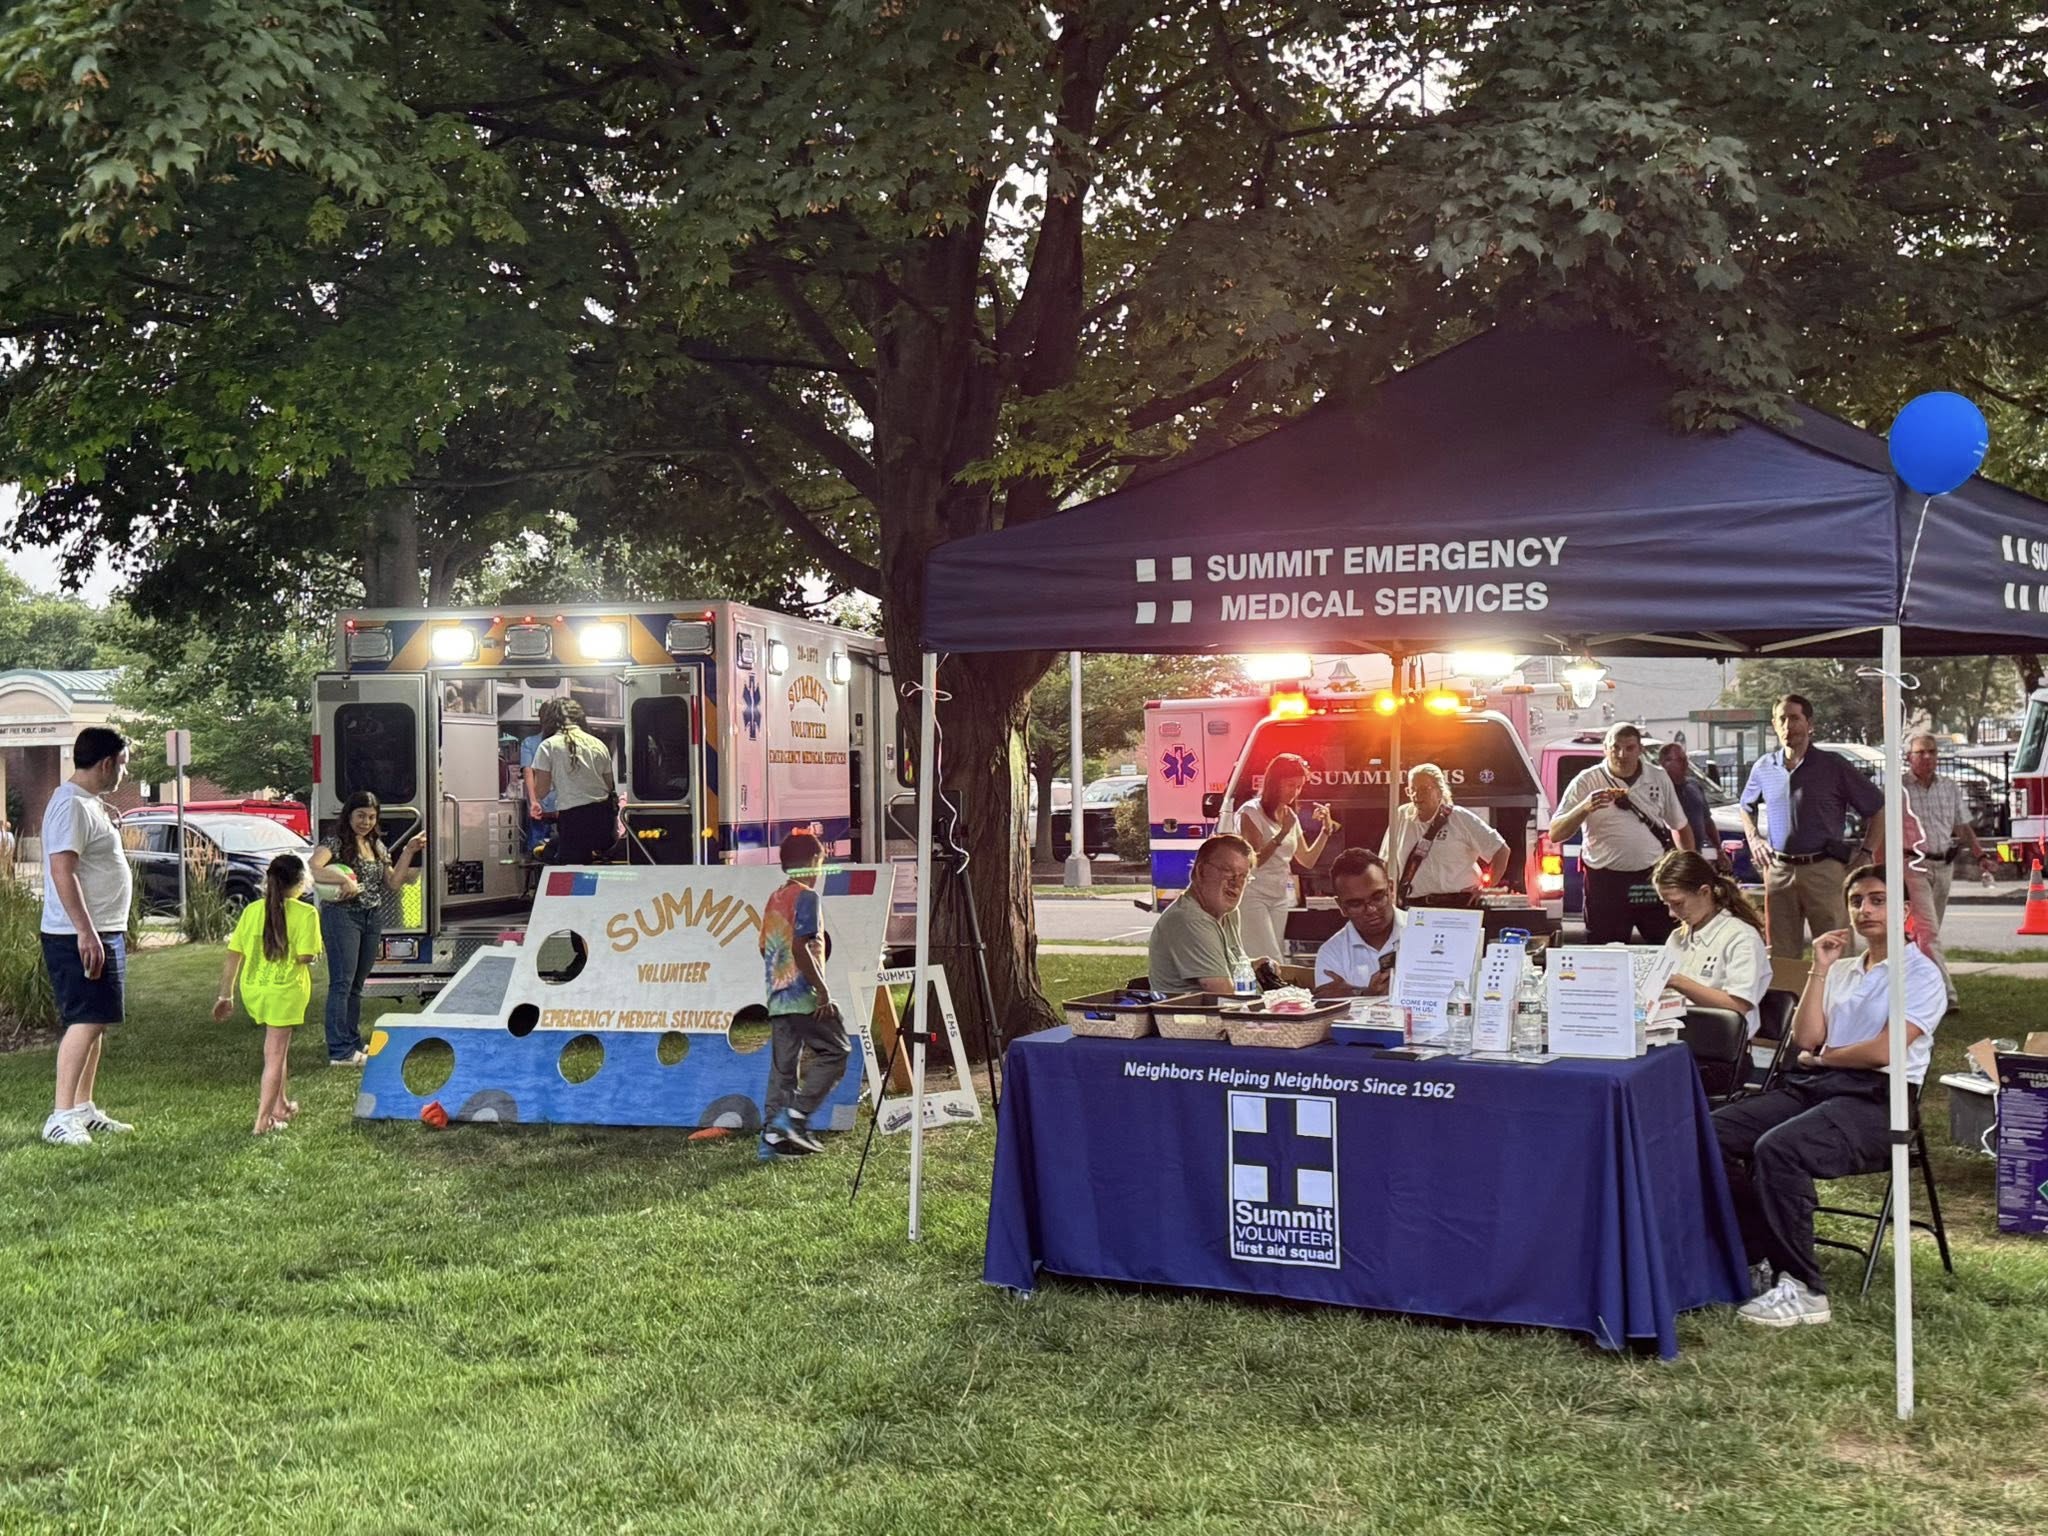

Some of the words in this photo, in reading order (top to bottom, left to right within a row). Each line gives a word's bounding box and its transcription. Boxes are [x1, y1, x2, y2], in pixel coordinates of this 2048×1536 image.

[1206, 548, 1334, 582] SUMMIT
[1344, 536, 1568, 574] EMERGENCY
[1221, 590, 1364, 621] MEDICAL
[1374, 582, 1549, 617] SERVICES
[787, 675, 829, 712] SUMMIT
[791, 720, 827, 739] VOLUNTEER
[769, 750, 801, 764] EMERGENCY
[802, 751, 824, 765] MEDICAL
[606, 887, 762, 952] SUMMIT
[637, 962, 711, 984] VOLUNTEER
[876, 970, 916, 982] SUMMIT
[540, 1009, 616, 1028] EMERGENCY
[616, 1010, 669, 1029] MEDICAL
[670, 1010, 735, 1030] SERVICES
[946, 1013, 958, 1038] EMS
[859, 1025, 873, 1057] JOIN
[1124, 1061, 1204, 1081] Neighbors
[1208, 1067, 1270, 1089] Helping
[1274, 1072, 1359, 1092] Neighbors
[1362, 1078, 1408, 1096] Since
[1411, 1081, 1456, 1099] 1962
[1235, 1201, 1334, 1232] Summit
[1235, 1225, 1333, 1248] VOLUNTEER
[1235, 1241, 1264, 1256] first
[1266, 1244, 1287, 1258] aid
[1289, 1248, 1334, 1262] squad
